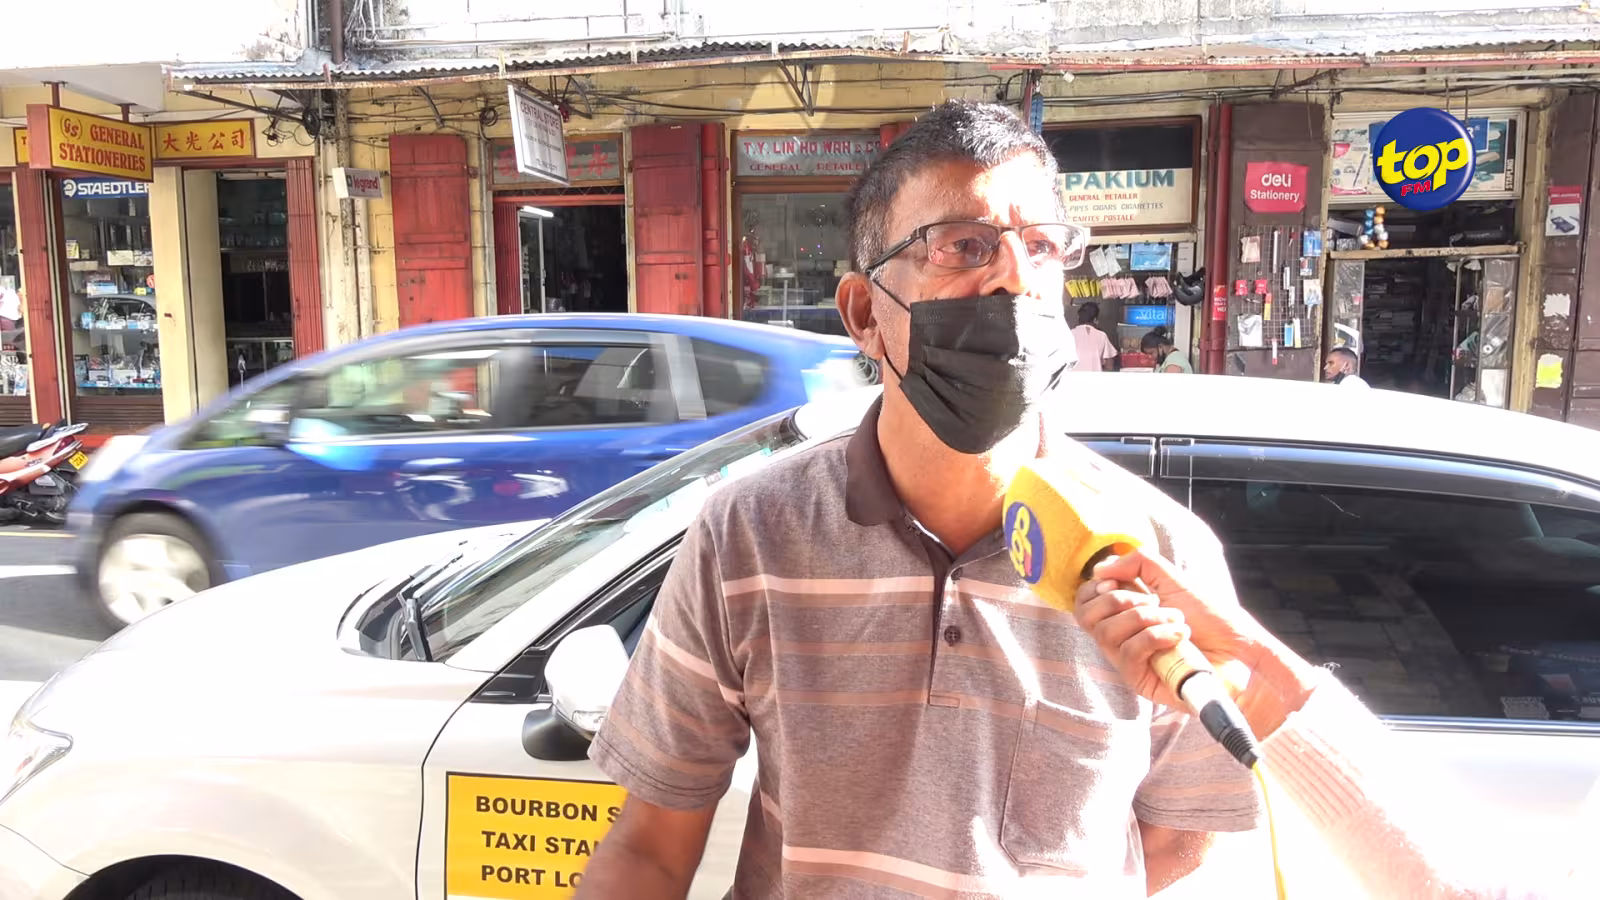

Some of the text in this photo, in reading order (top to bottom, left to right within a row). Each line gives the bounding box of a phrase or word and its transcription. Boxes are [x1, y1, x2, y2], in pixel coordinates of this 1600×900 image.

[89, 123, 145, 150] GENERAL
[163, 128, 245, 152] 大光公司
[773, 141, 795, 153] LIN
[58, 142, 146, 173] STATIONERIES
[750, 162, 800, 171] GENERAL
[1065, 170, 1175, 191] PAKIUM
[1261, 173, 1292, 187] deli
[1069, 194, 1100, 202] GENERAL
[1092, 203, 1117, 211] CIGARS
[1120, 202, 1164, 210] CIGARETTES
[1250, 189, 1300, 203] Stationery
[476, 795, 598, 822] BOURBON
[481, 830, 536, 852] TAXI
[481, 864, 546, 886] PORT
